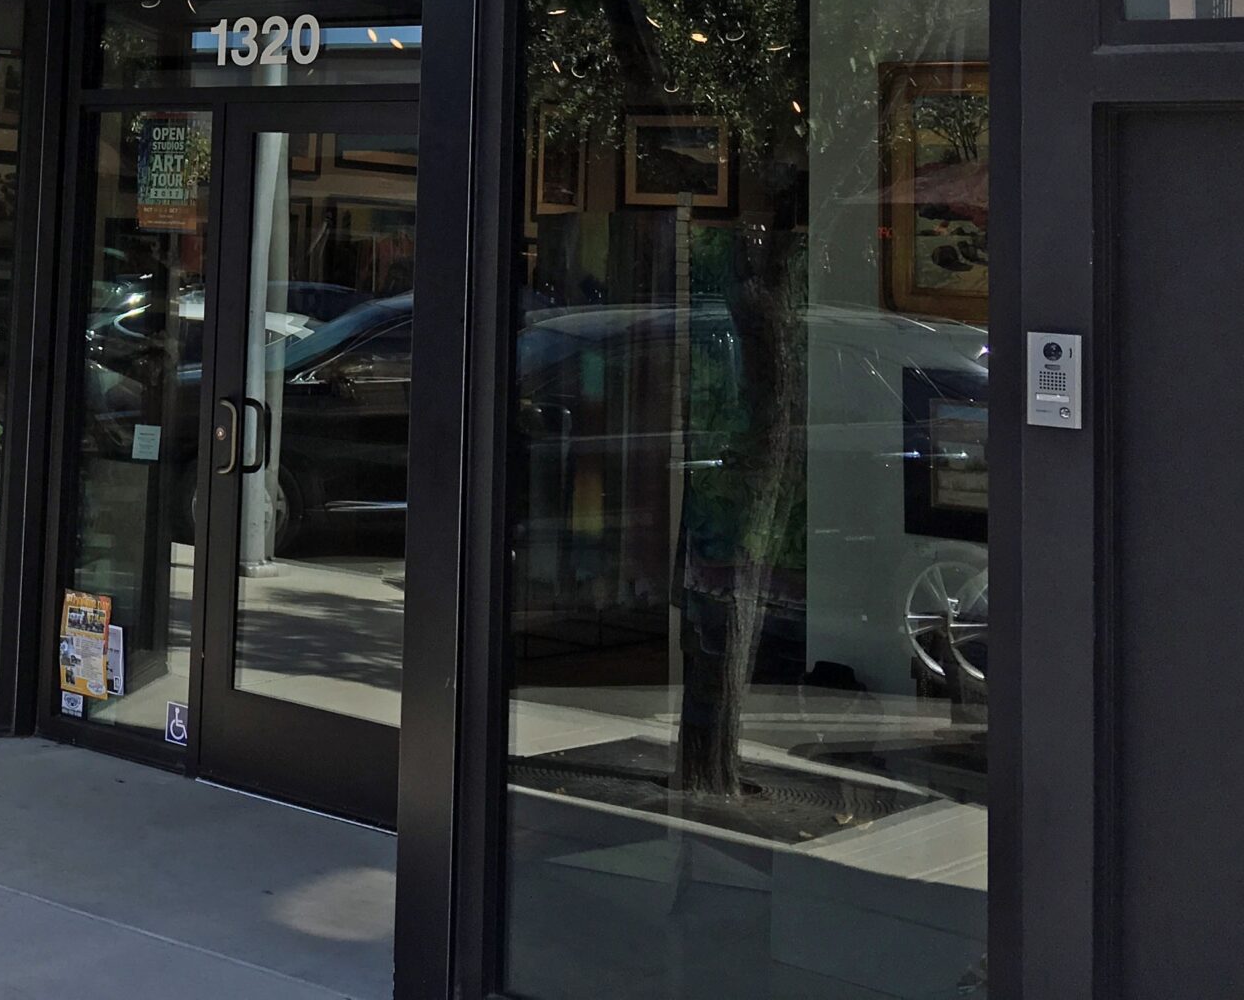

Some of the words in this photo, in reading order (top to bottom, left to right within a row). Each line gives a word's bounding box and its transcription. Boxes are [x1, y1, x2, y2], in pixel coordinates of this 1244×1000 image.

[210, 14, 320, 66] 1320
[152, 127, 185, 141] OPEN
[152, 142, 185, 151] STUDIOS
[151, 154, 184, 172] ART
[151, 173, 183, 187] TOUR
